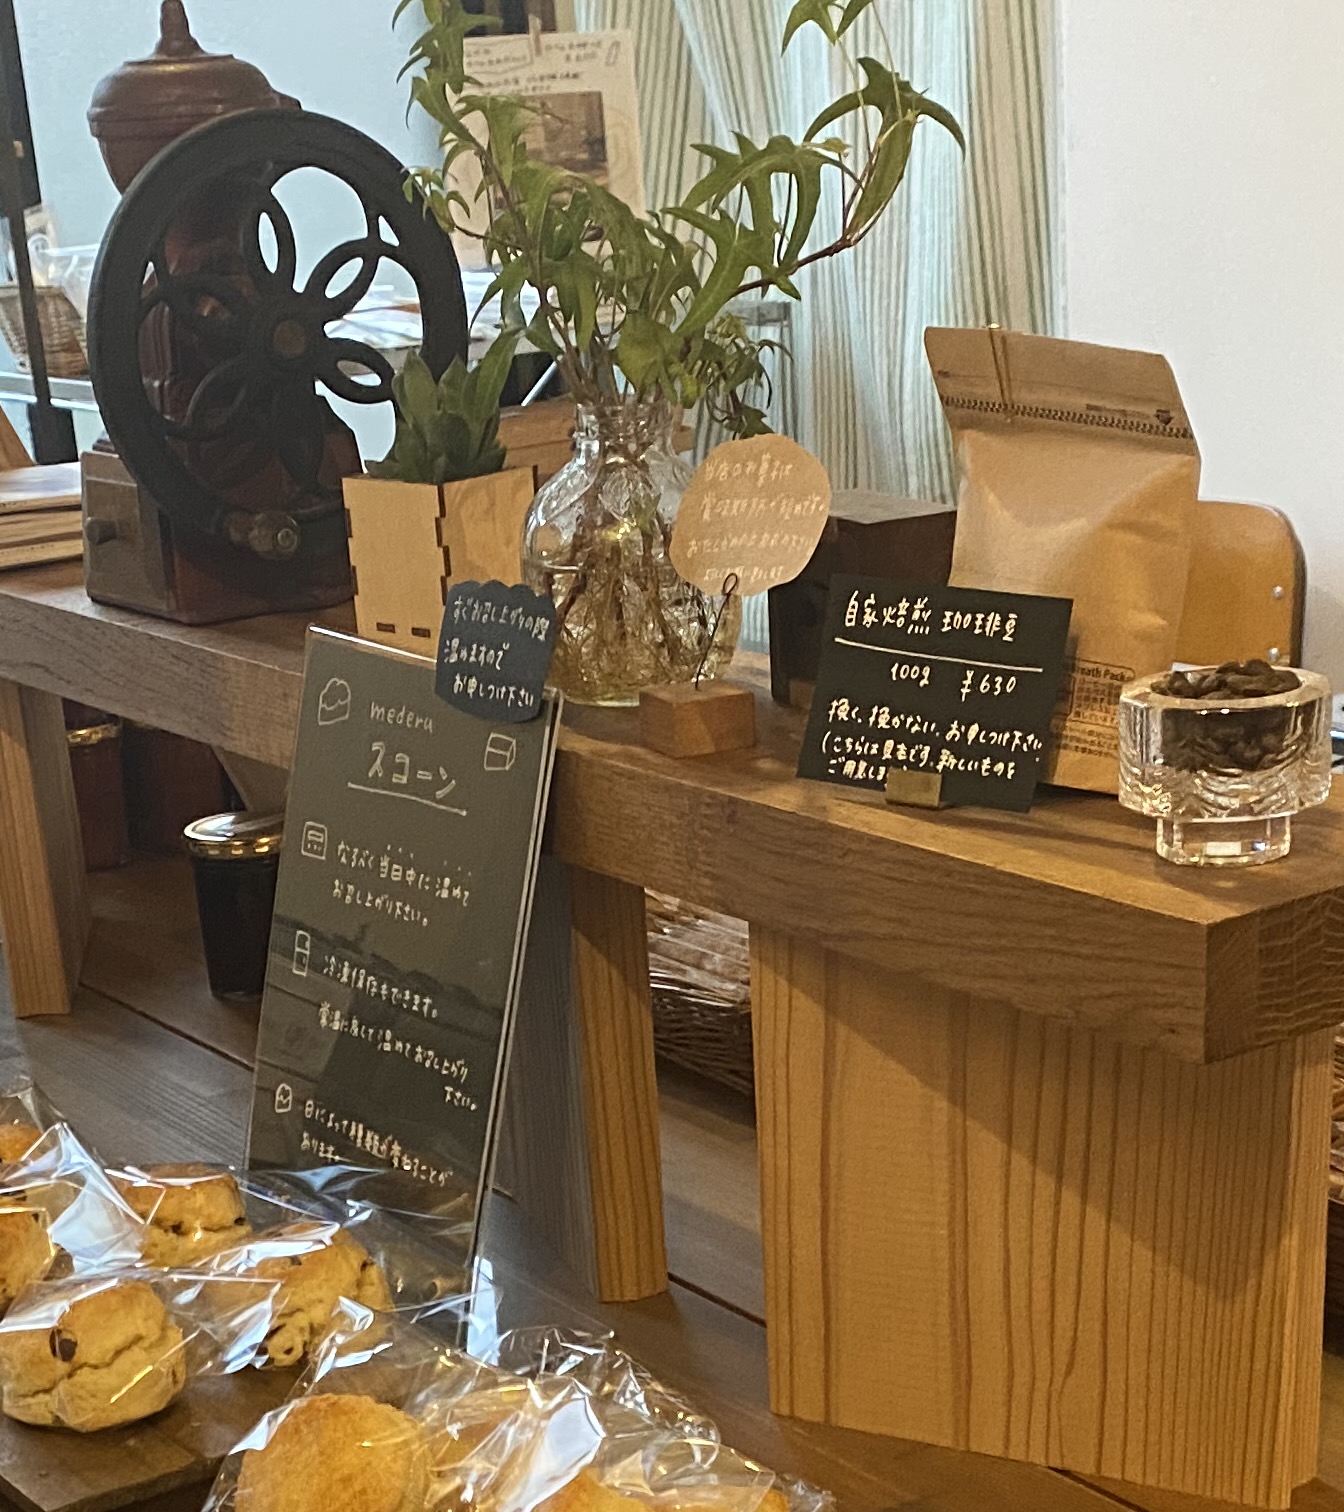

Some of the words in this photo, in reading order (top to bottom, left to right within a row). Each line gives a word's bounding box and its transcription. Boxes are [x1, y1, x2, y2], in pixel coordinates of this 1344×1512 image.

[844, 590, 932, 636] 自家焙煎
[941, 610, 1018, 643] 珈琲豆
[444, 637, 510, 671] 温めますので
[453, 673, 534, 708] お申しつけ下さい
[890, 662, 931, 688] 100g
[960, 670, 1018, 703] ¥630
[370, 701, 433, 734] mederu
[368, 741, 457, 799] スコーン
